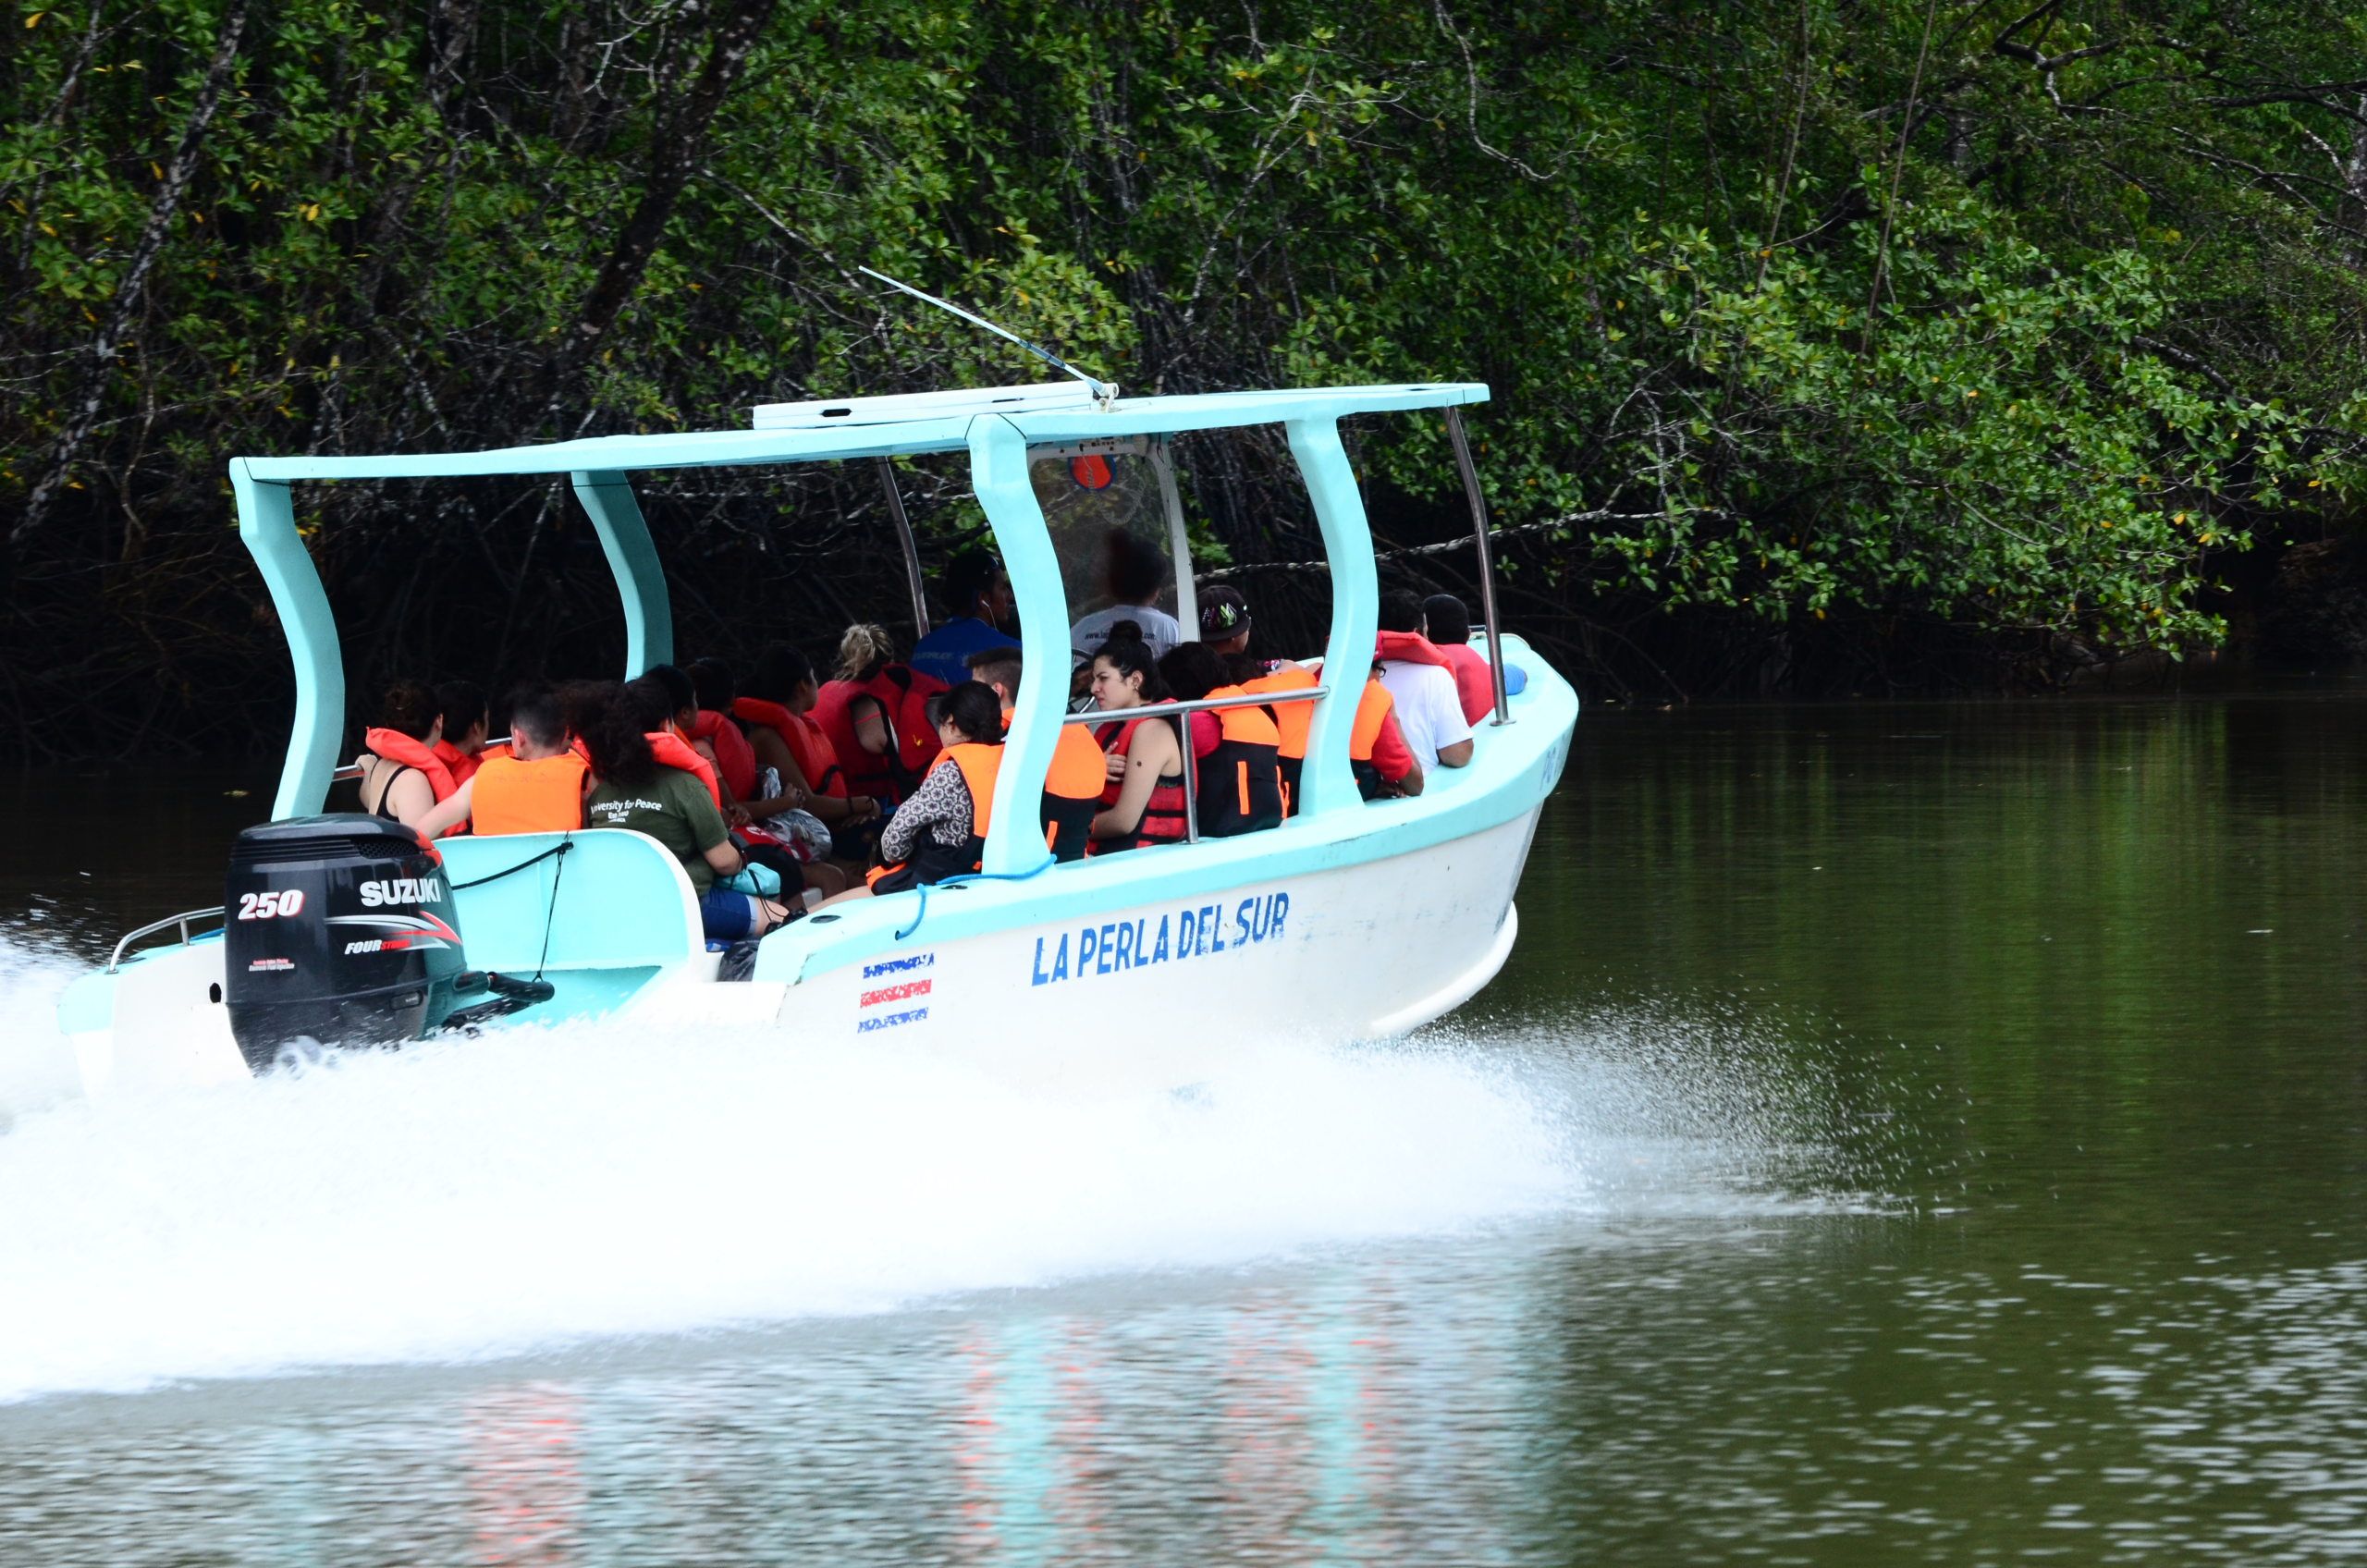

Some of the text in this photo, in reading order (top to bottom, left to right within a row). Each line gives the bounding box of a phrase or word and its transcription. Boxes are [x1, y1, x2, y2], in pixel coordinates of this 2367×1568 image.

[624, 800, 635, 810] for
[634, 798, 663, 811] Peace
[238, 889, 304, 920] 250
[360, 878, 441, 907] SUZUKI
[1031, 892, 1290, 986] LA PERLA DEL SUR
